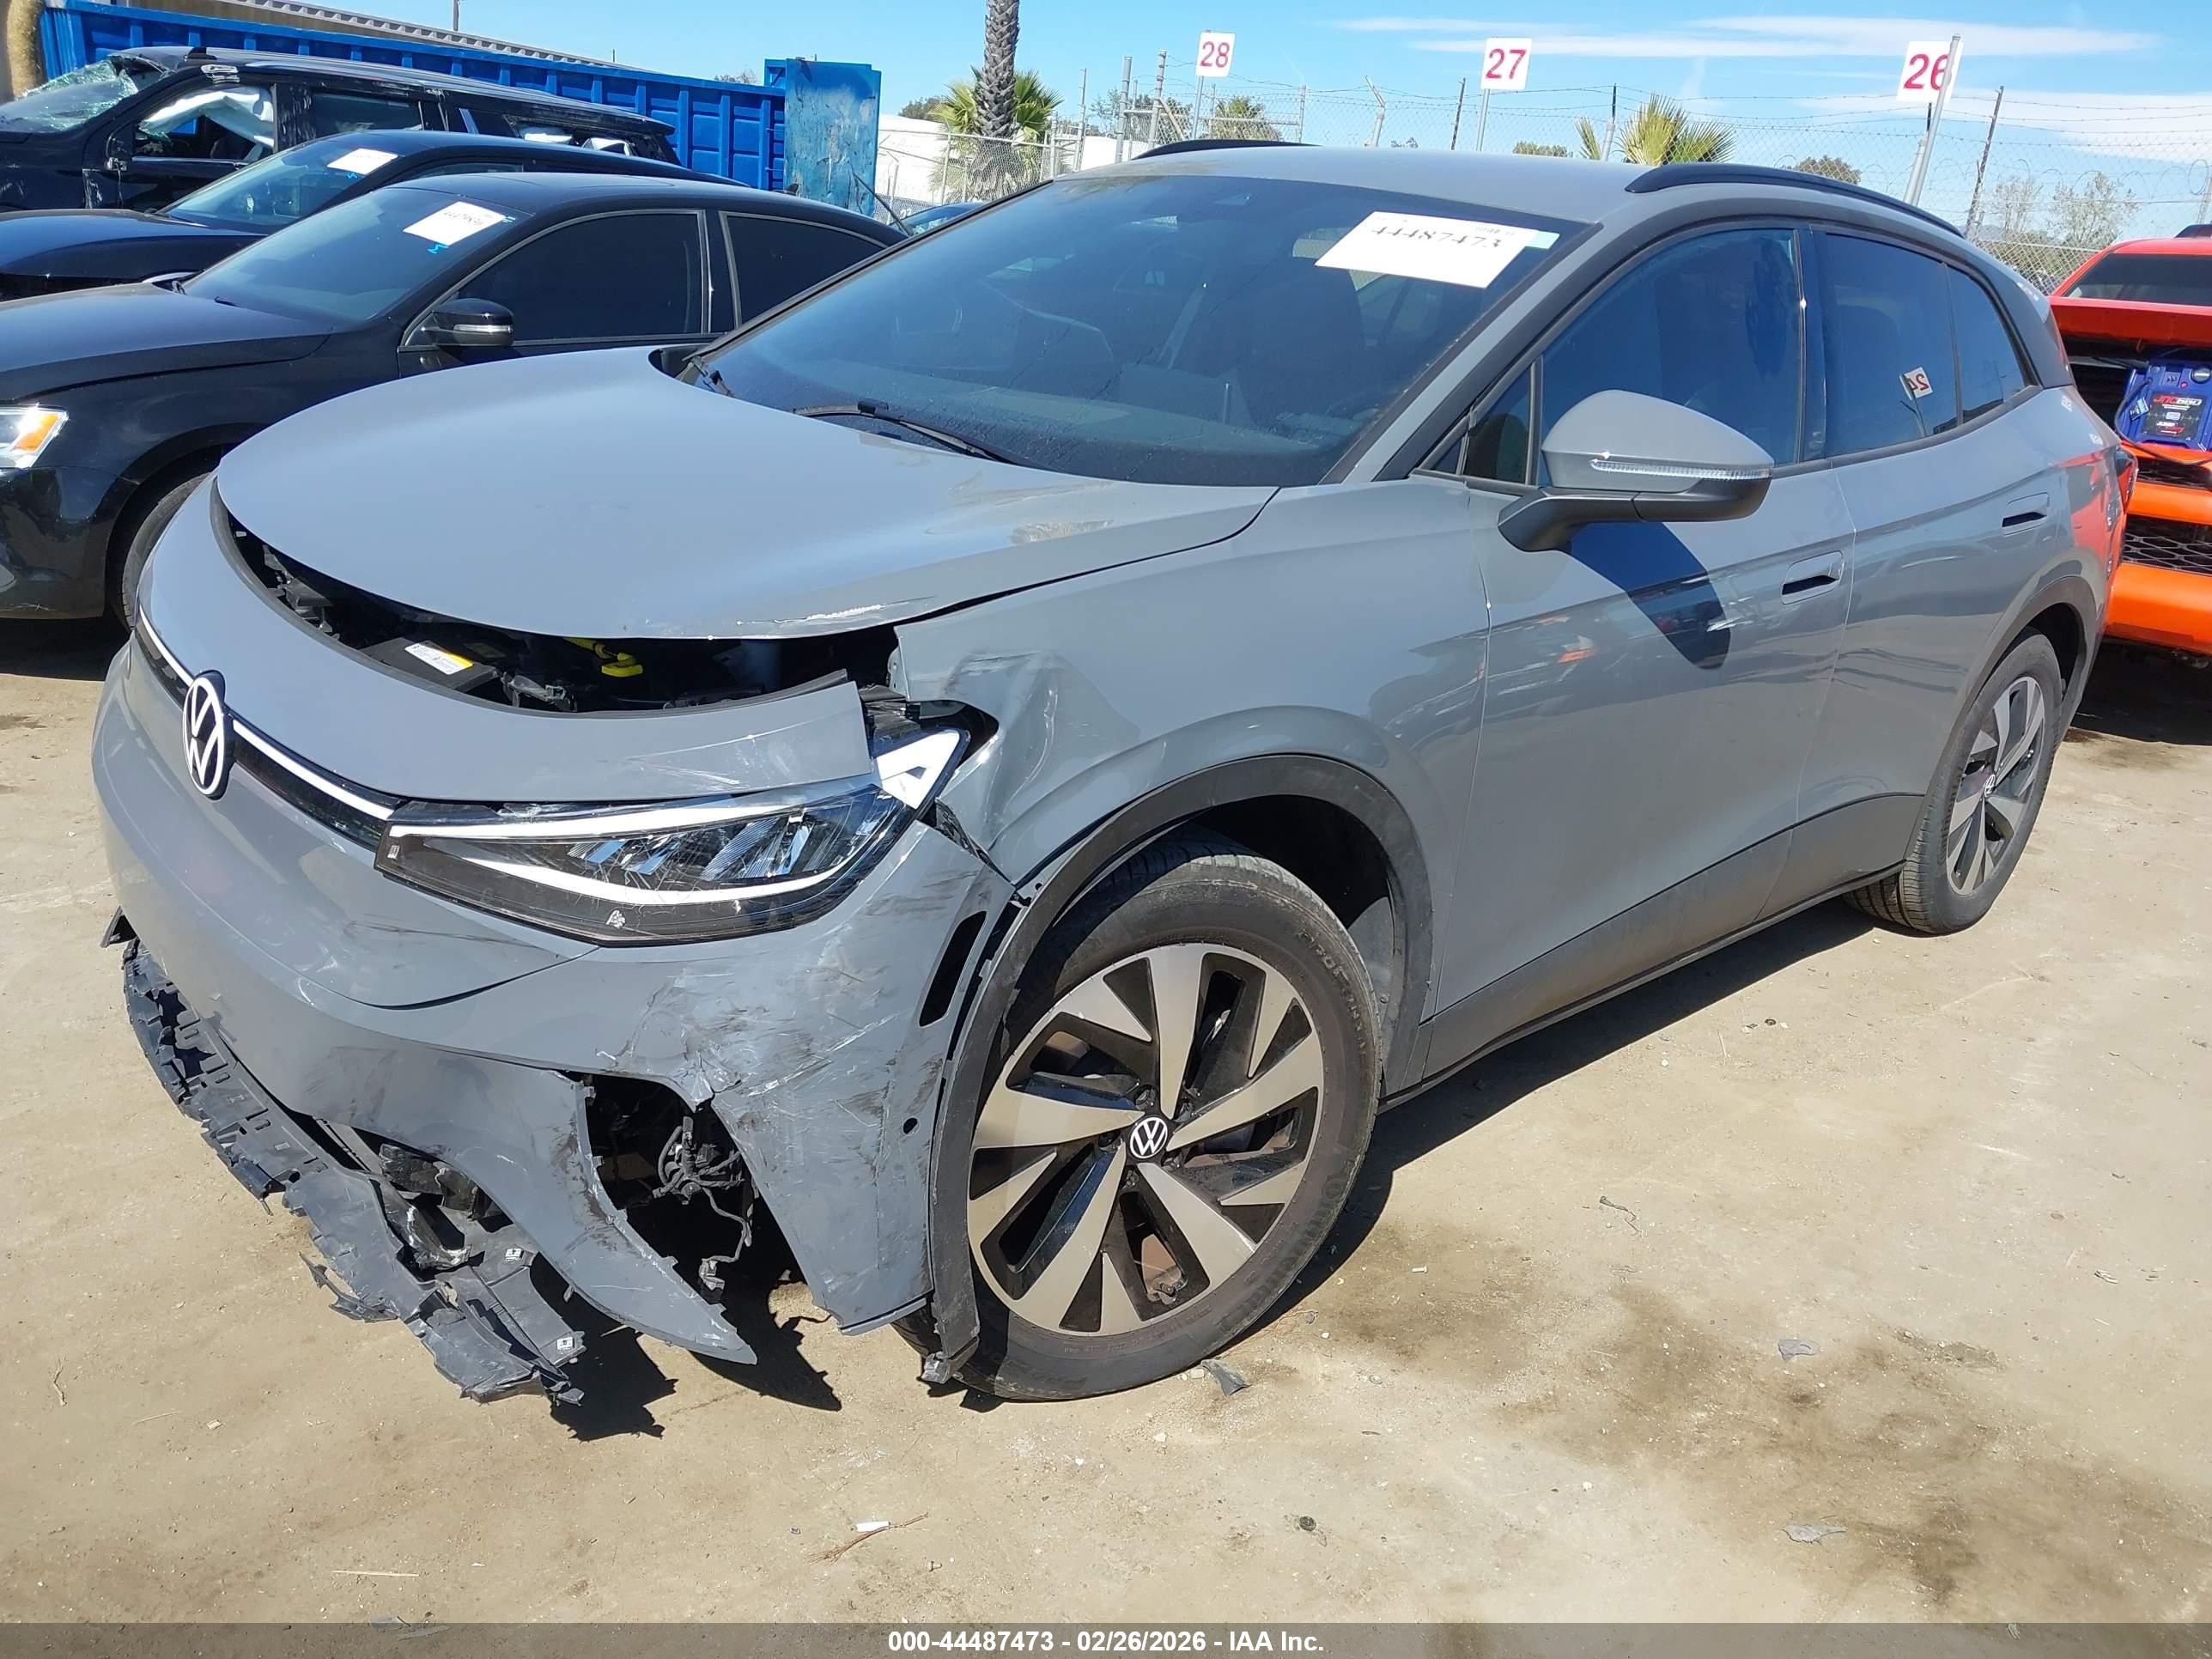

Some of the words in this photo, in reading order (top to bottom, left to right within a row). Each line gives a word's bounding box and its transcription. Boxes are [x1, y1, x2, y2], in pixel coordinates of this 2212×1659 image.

[1200, 41, 1230, 68] 28
[1486, 48, 1526, 79] 27
[1903, 53, 1949, 90] 26
[1370, 226, 1502, 248] 44487473
[183, 678, 224, 794] VW
[1130, 1117, 1168, 1159] VW
